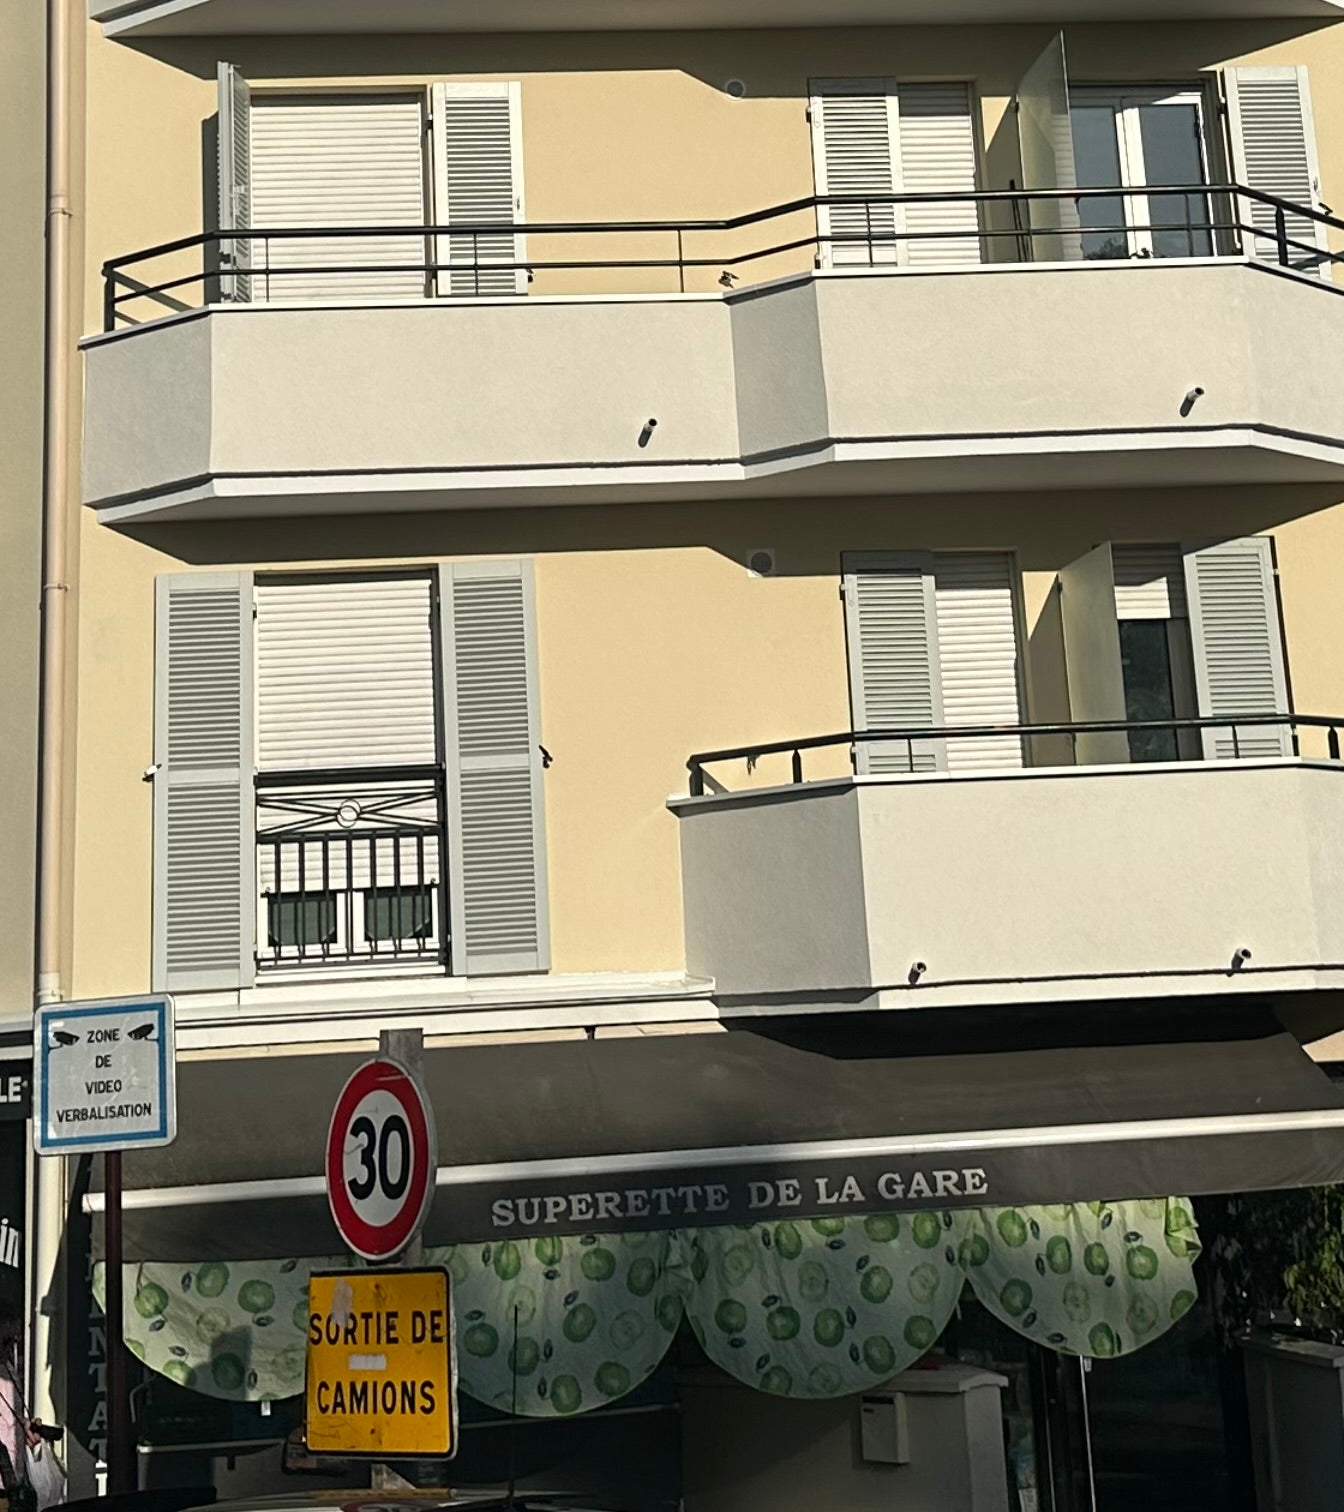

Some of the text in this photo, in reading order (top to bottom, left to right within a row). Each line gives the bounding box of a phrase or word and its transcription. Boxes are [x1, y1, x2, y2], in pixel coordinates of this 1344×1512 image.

[87, 1028, 120, 1043] ZONE
[95, 1055, 112, 1068] DE
[85, 1080, 122, 1095] VIDEO
[56, 1103, 152, 1123] VERBALISATION
[348, 1115, 410, 1200] 30
[492, 1168, 989, 1227] SUPERETTE DE LA GARE
[309, 1309, 444, 1346] SORTIE DE
[317, 1379, 435, 1415] CAMIONS
